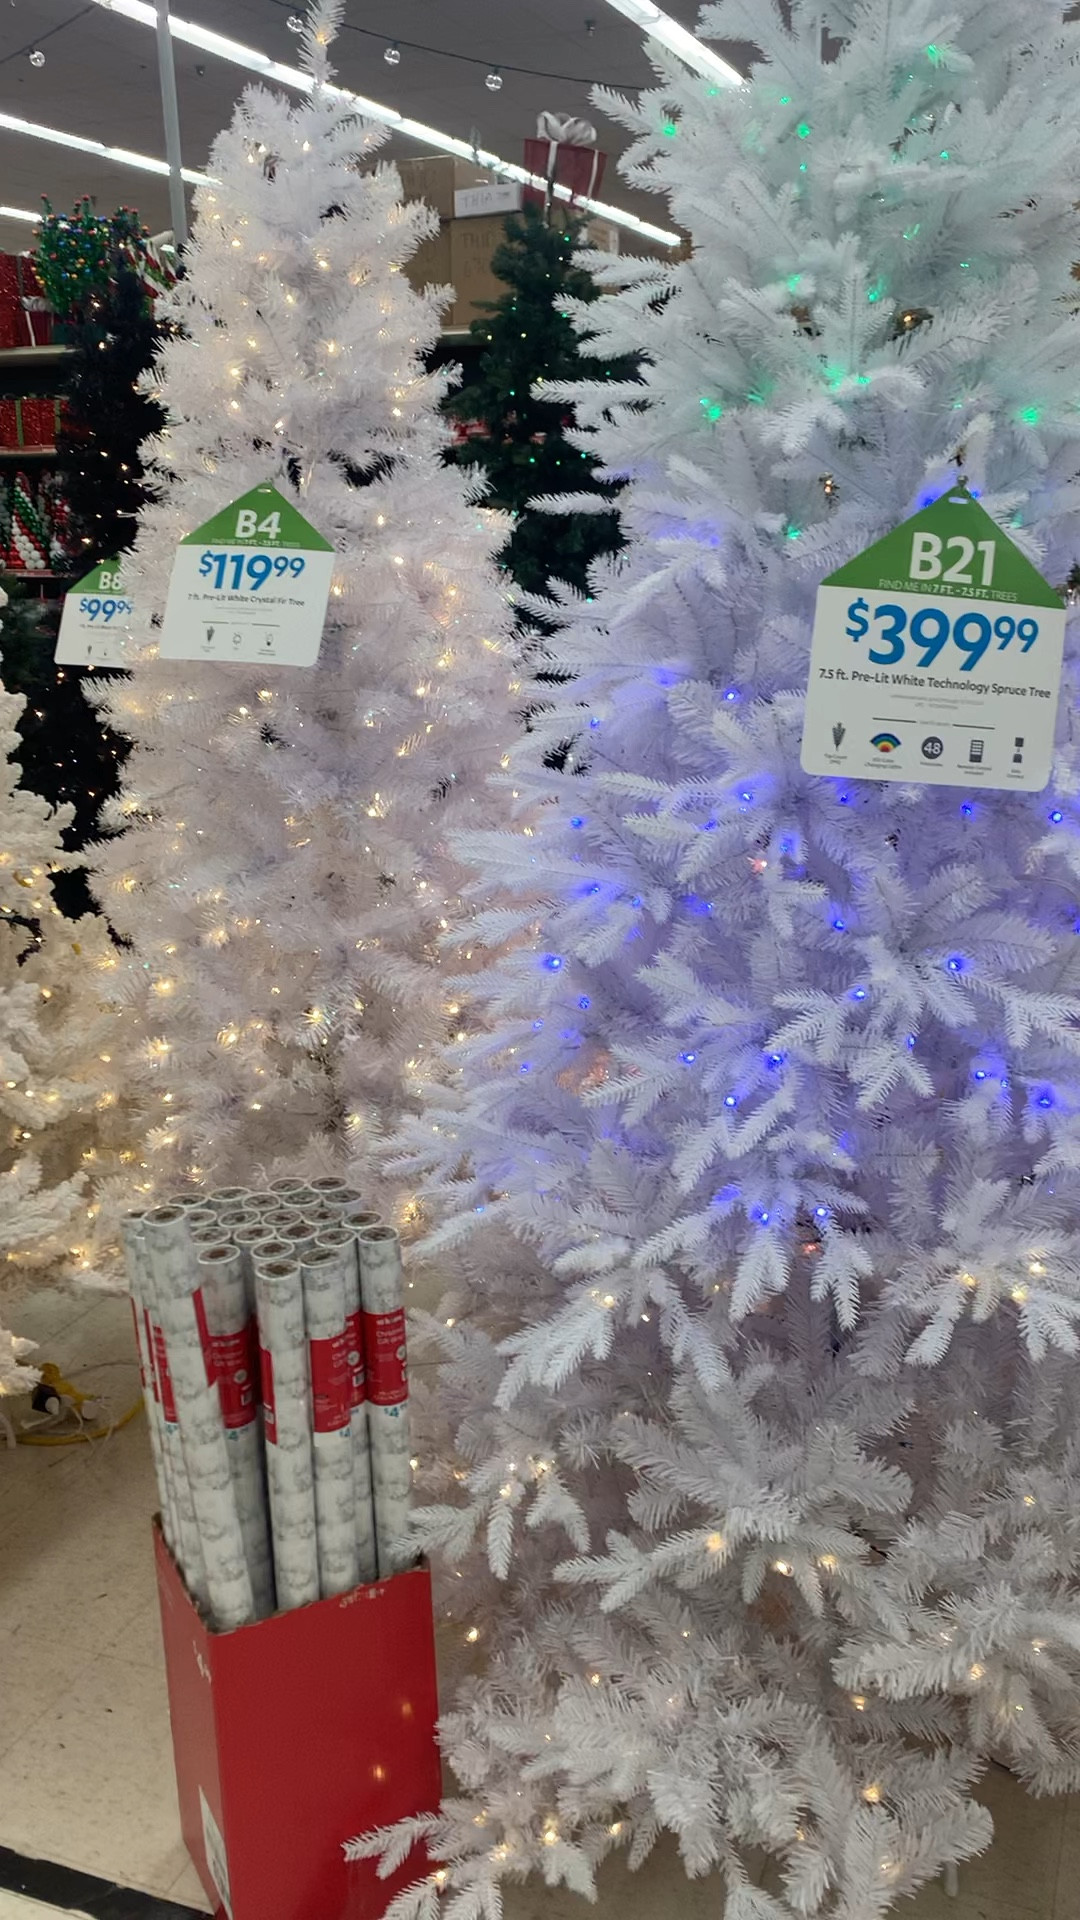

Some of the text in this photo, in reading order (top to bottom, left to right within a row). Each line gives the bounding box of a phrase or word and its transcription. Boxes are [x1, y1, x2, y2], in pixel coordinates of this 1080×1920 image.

[235, 509, 282, 540] B4
[909, 531, 996, 586] B21
[228, 594, 249, 602] White
[289, 598, 305, 607] Tree
[878, 579, 902, 590] FIND
[991, 590, 1018, 602] TREES
[818, 668, 1051, 699] 7.5 ft. Pre-Lit White Technology Spruce Tree
[923, 742, 941, 755] 48
